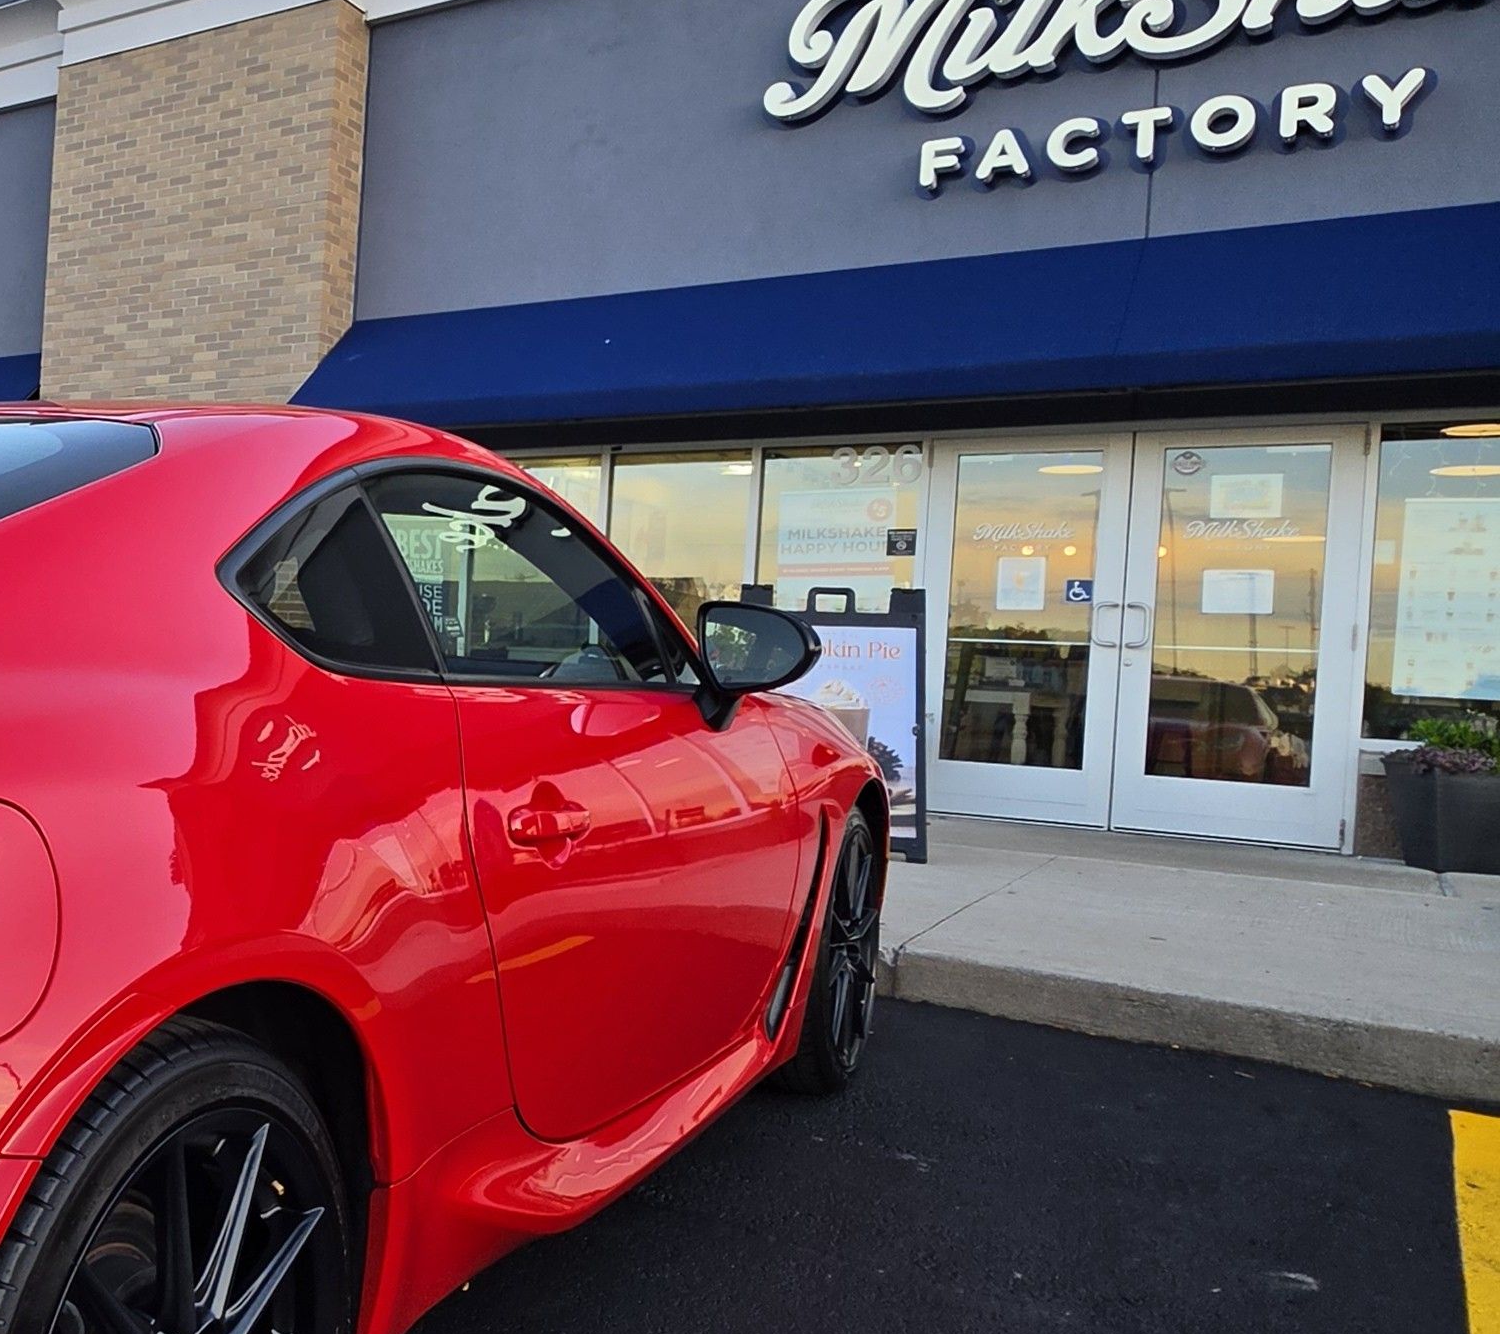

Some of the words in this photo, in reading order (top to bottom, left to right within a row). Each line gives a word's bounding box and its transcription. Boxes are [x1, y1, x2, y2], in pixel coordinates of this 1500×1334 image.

[918, 67, 1427, 191] FACTORY
[830, 444, 923, 486] 326
[787, 526, 887, 540] MILKSHAKE
[973, 521, 1076, 542] MilkShake
[1181, 519, 1301, 541] MilkShake
[397, 529, 442, 560] BEST
[780, 542, 841, 555] HAPPY
[867, 641, 901, 660] Pie
